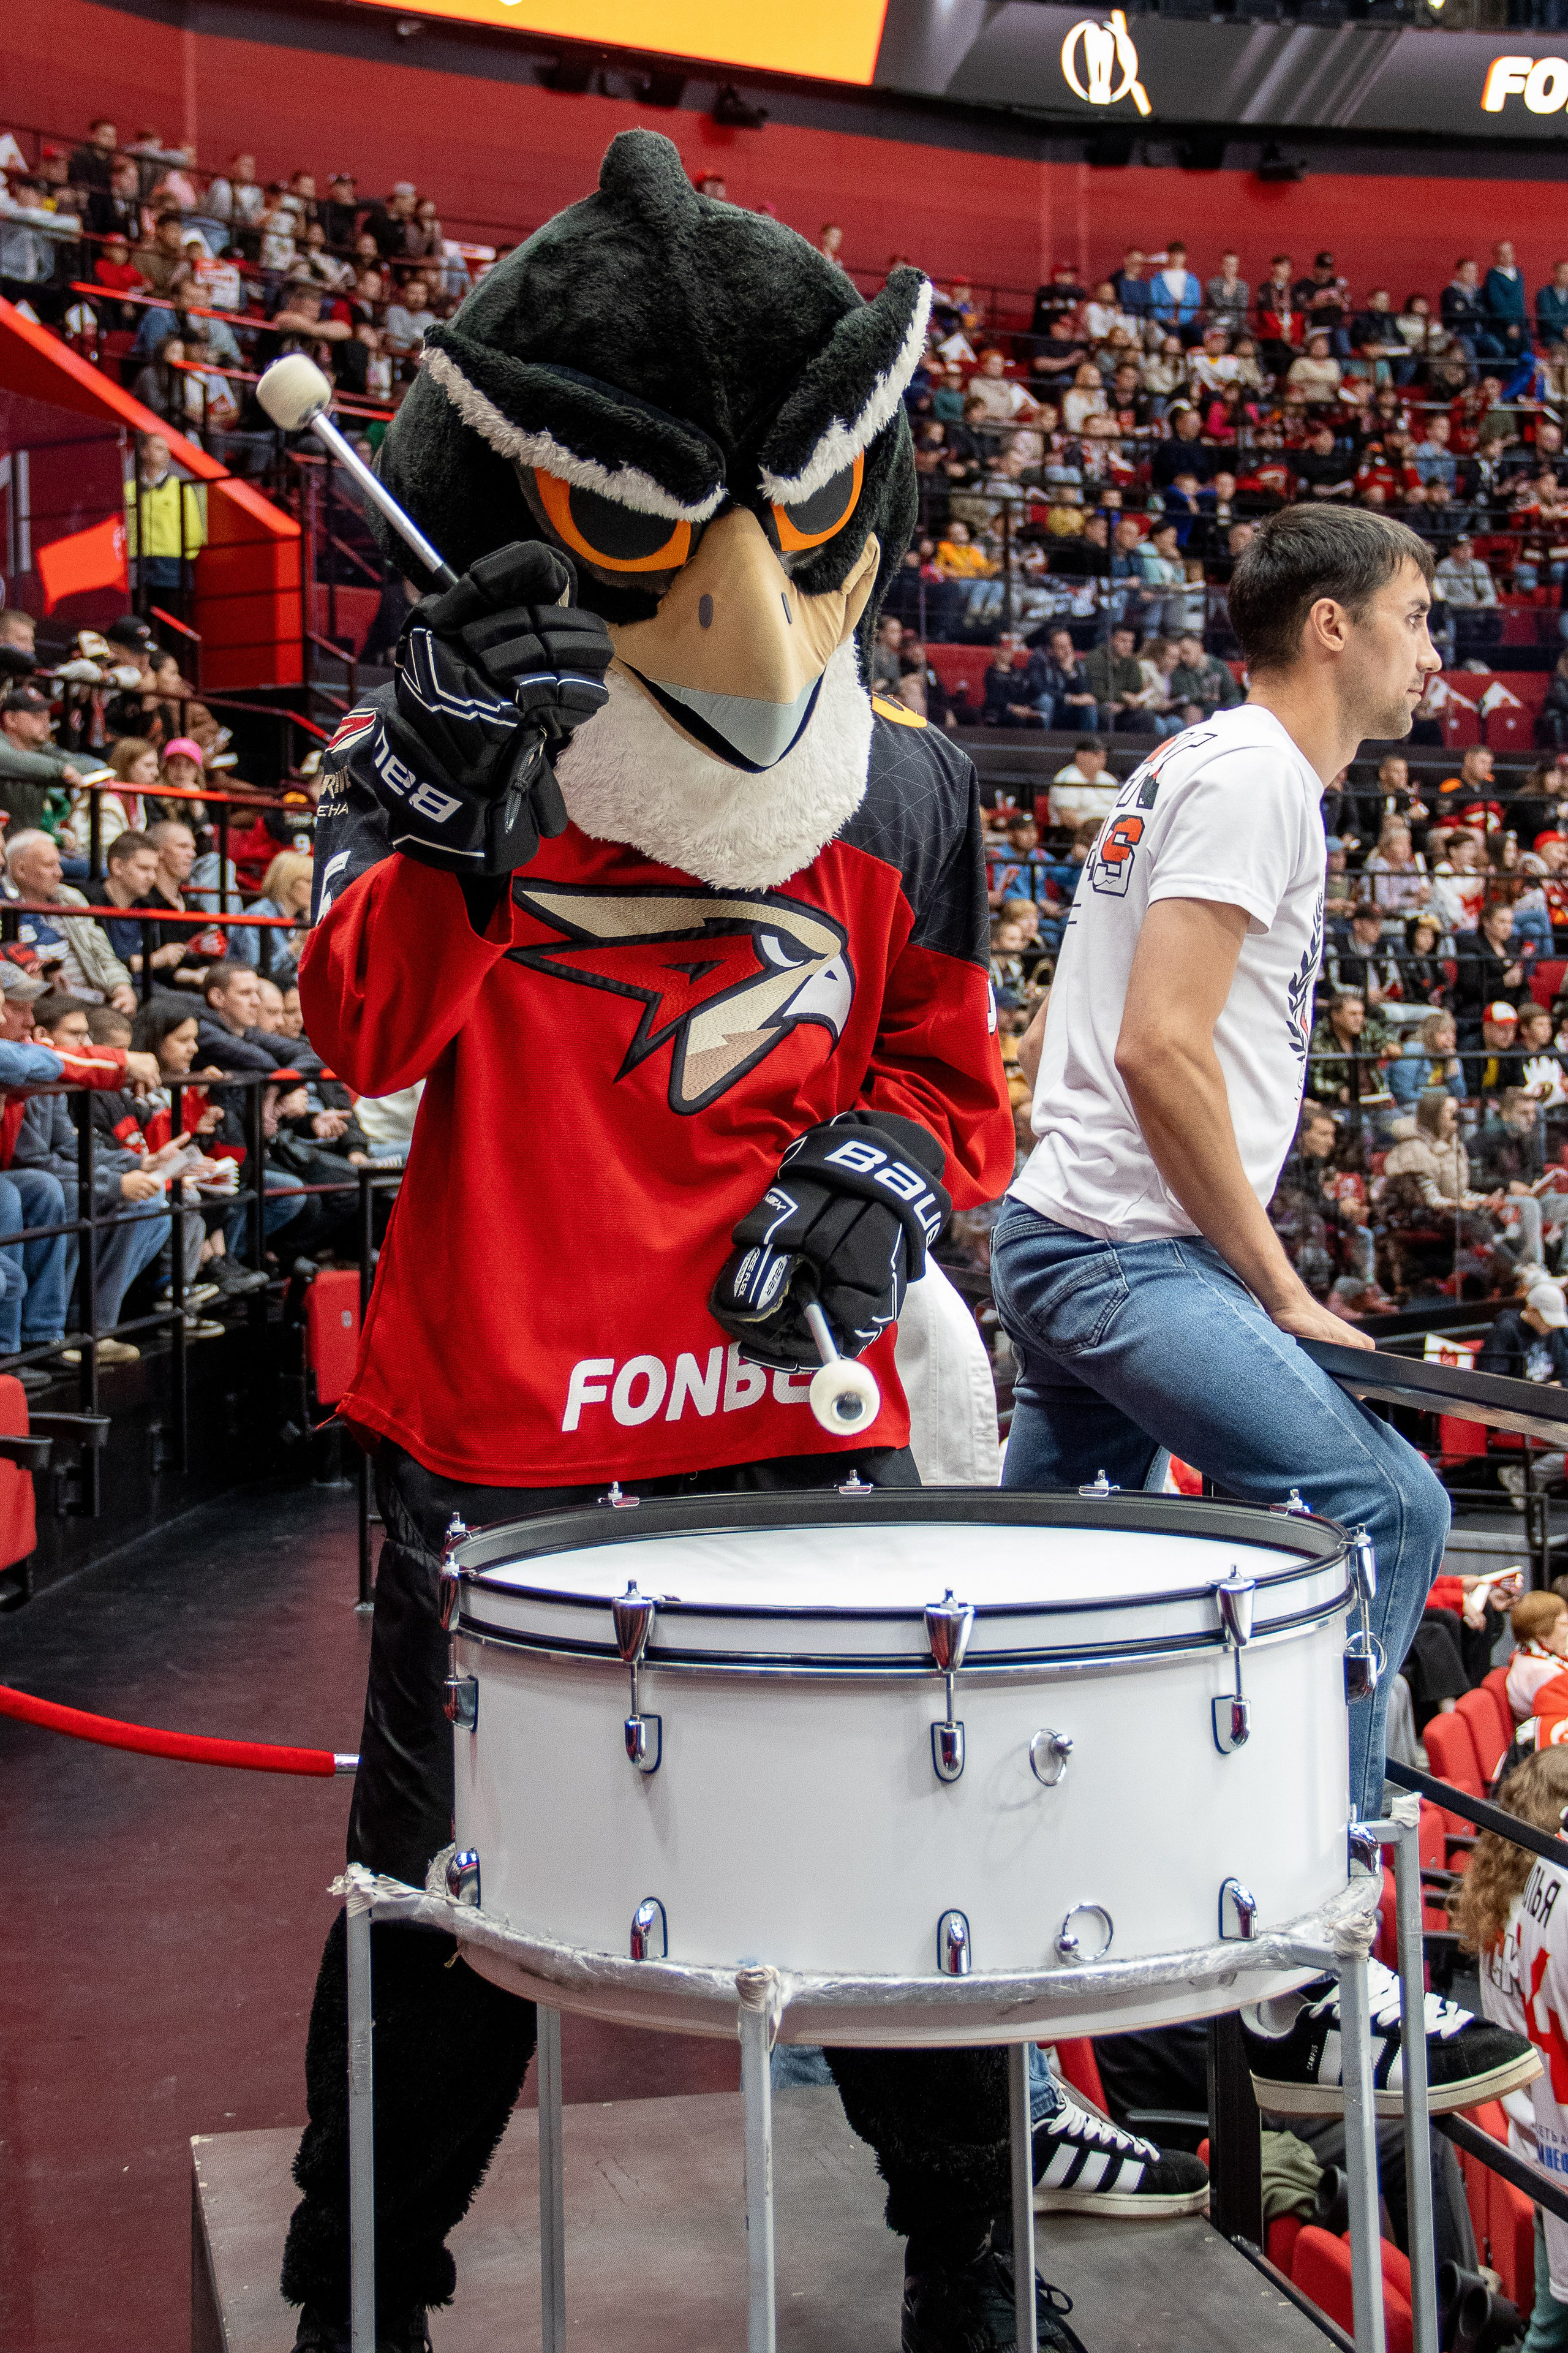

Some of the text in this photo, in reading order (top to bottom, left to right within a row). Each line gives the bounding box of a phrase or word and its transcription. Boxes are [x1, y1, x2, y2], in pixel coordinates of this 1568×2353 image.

[1480, 55, 1568, 115] FO
[562, 1342, 810, 1432] FONBE
[1306, 2044, 1319, 2071] CAMPUS
